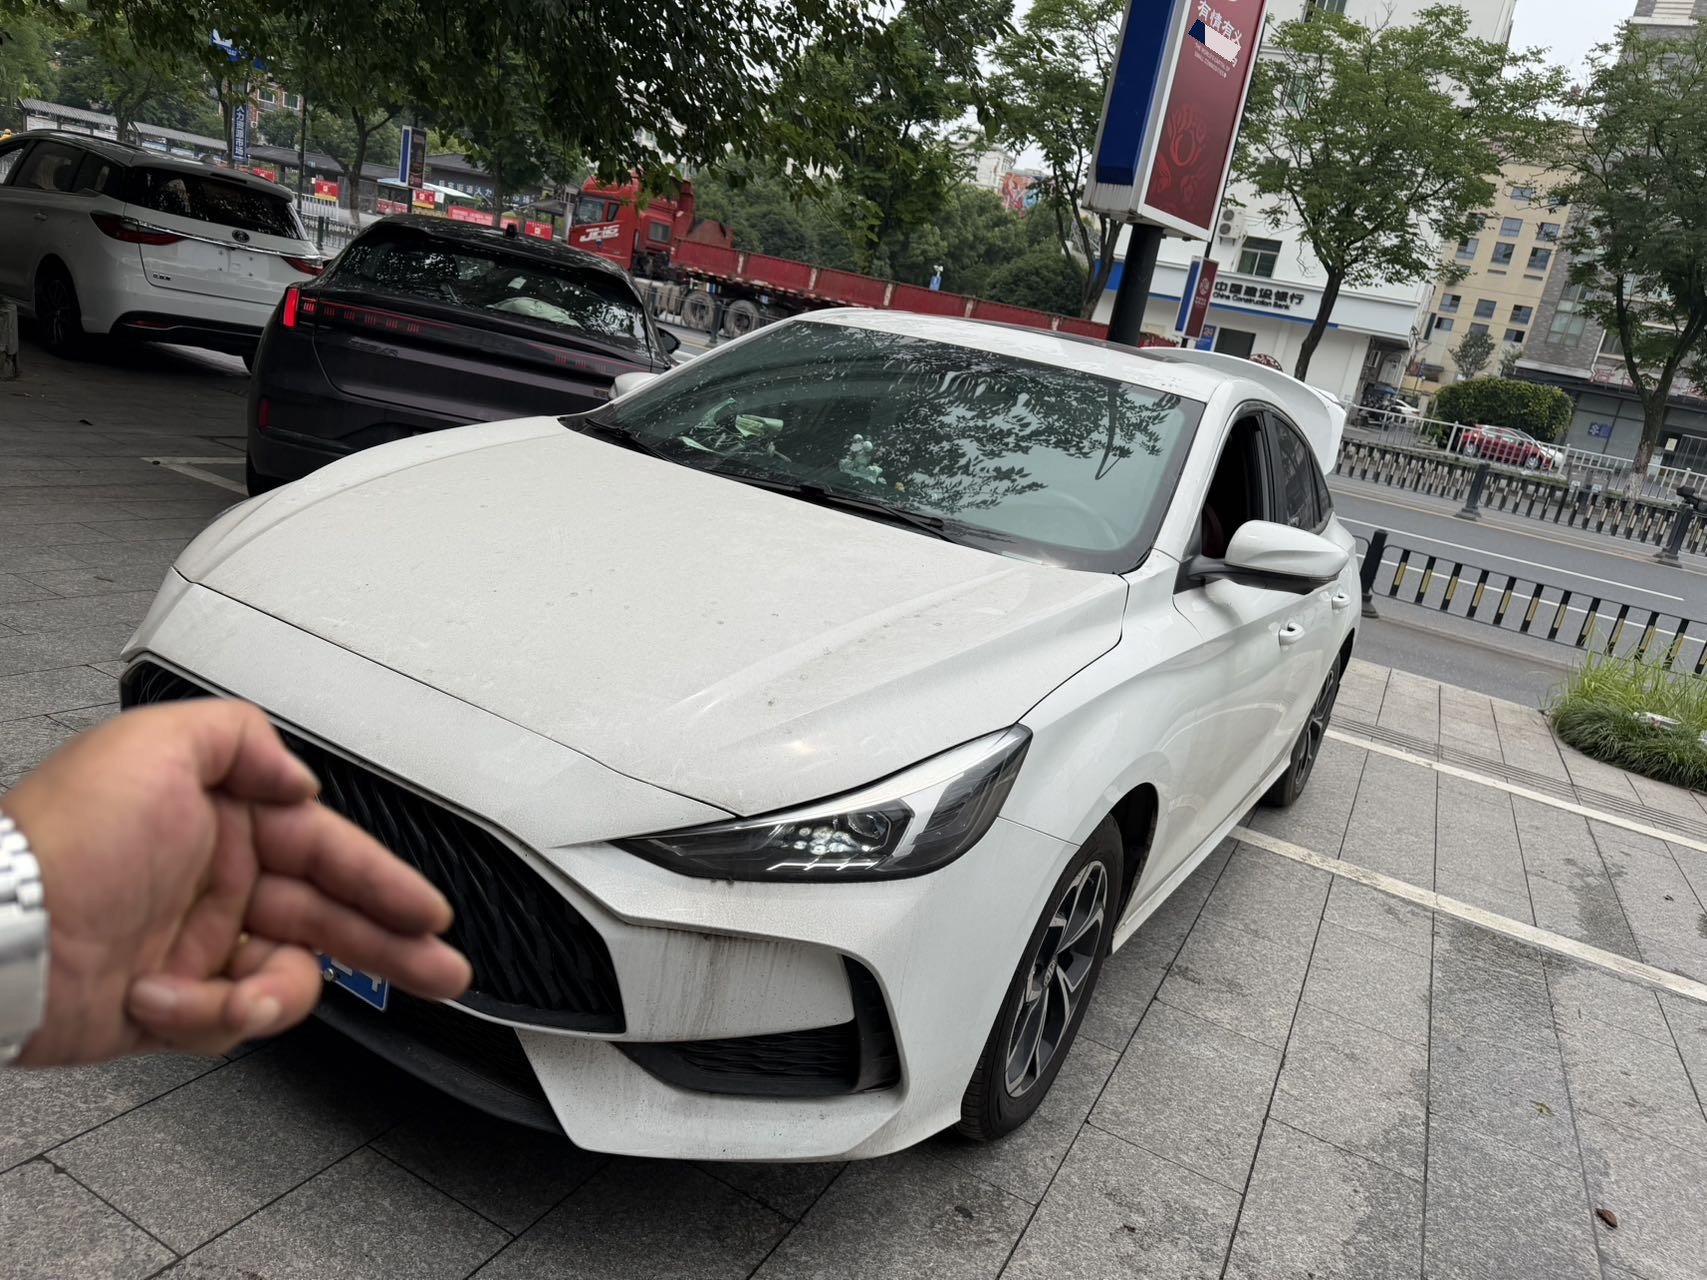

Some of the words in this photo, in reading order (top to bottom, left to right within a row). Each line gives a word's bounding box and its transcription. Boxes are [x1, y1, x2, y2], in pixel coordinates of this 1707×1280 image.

[1197, 0, 1242, 47] 有情有义
[235, 105, 245, 156] 人力资源市场
[1213, 291, 1231, 300] China
[1231, 294, 1272, 307] Construction
[1272, 301, 1291, 310] Bank
[1214, 281, 1305, 305] 中国建设银行
